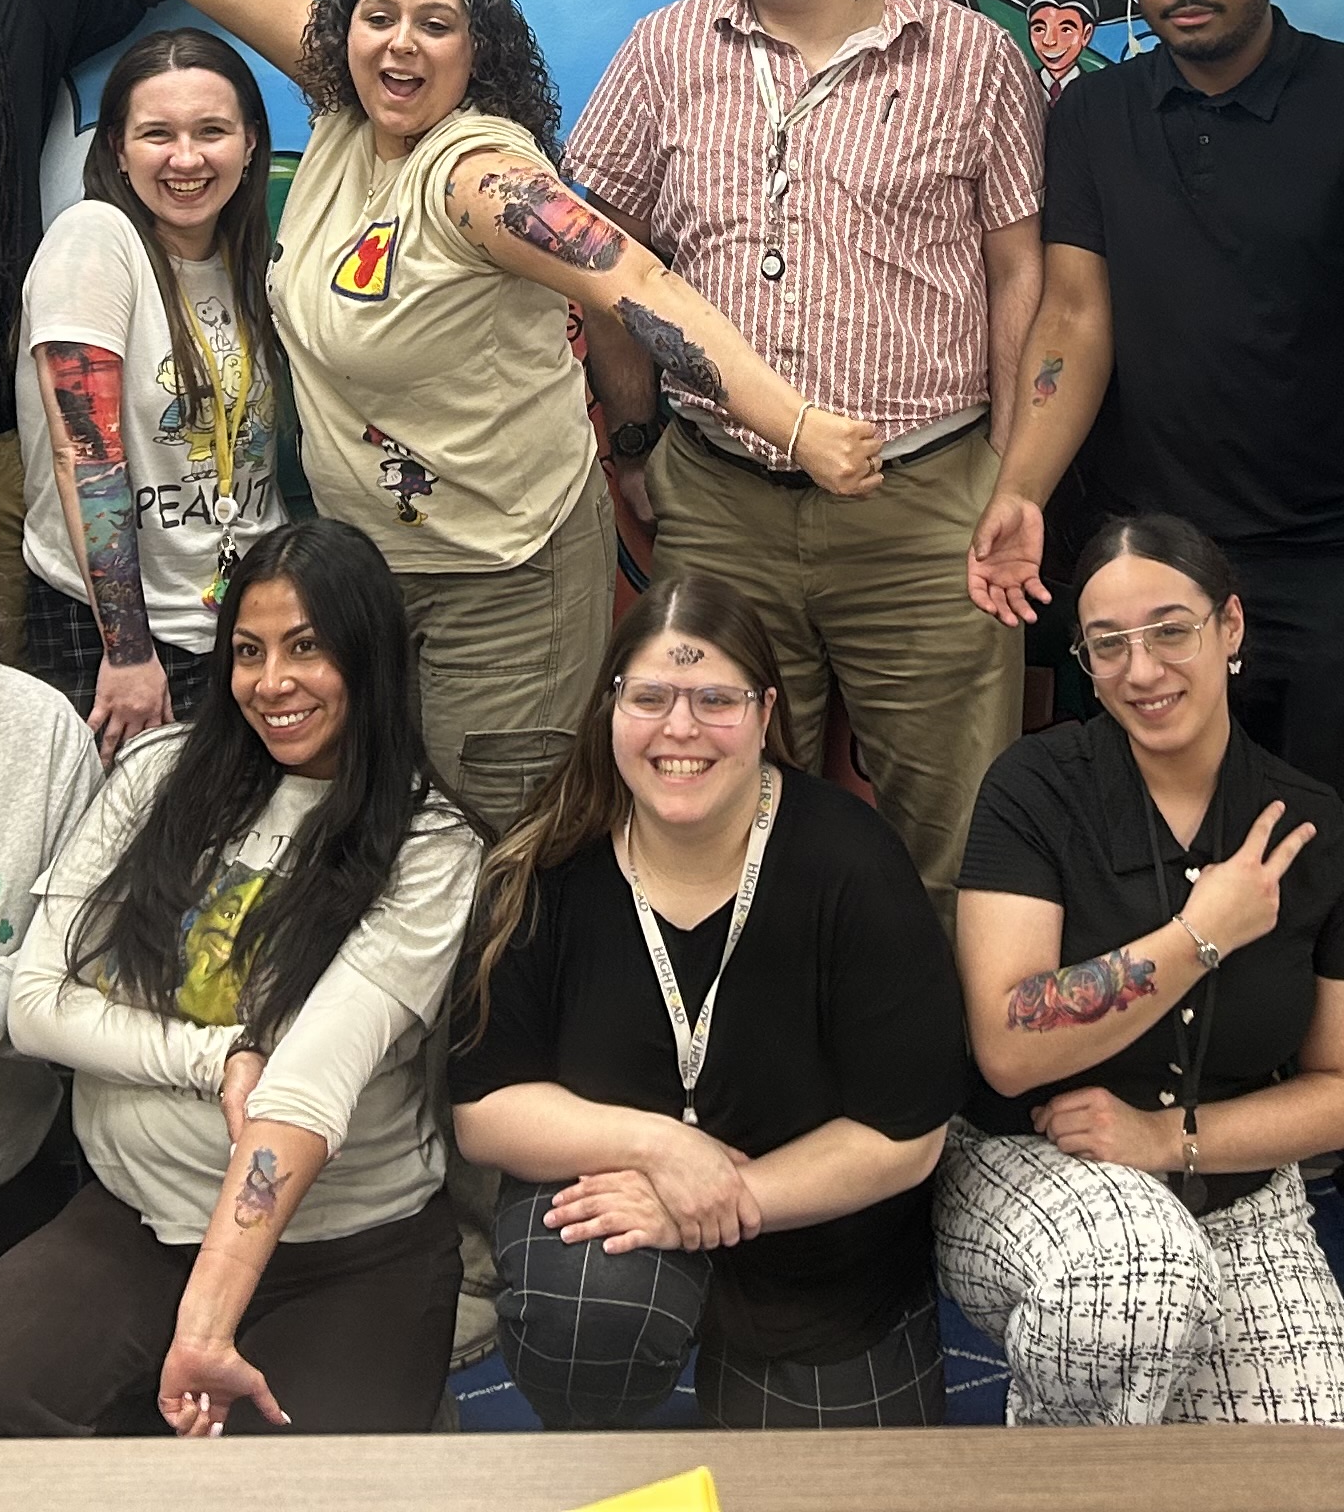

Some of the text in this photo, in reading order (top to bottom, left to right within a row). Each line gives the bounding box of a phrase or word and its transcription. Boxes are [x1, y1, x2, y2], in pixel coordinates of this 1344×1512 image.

[740, 862, 759, 901] HIGH
[653, 947, 685, 1024] HIGH ROAD
